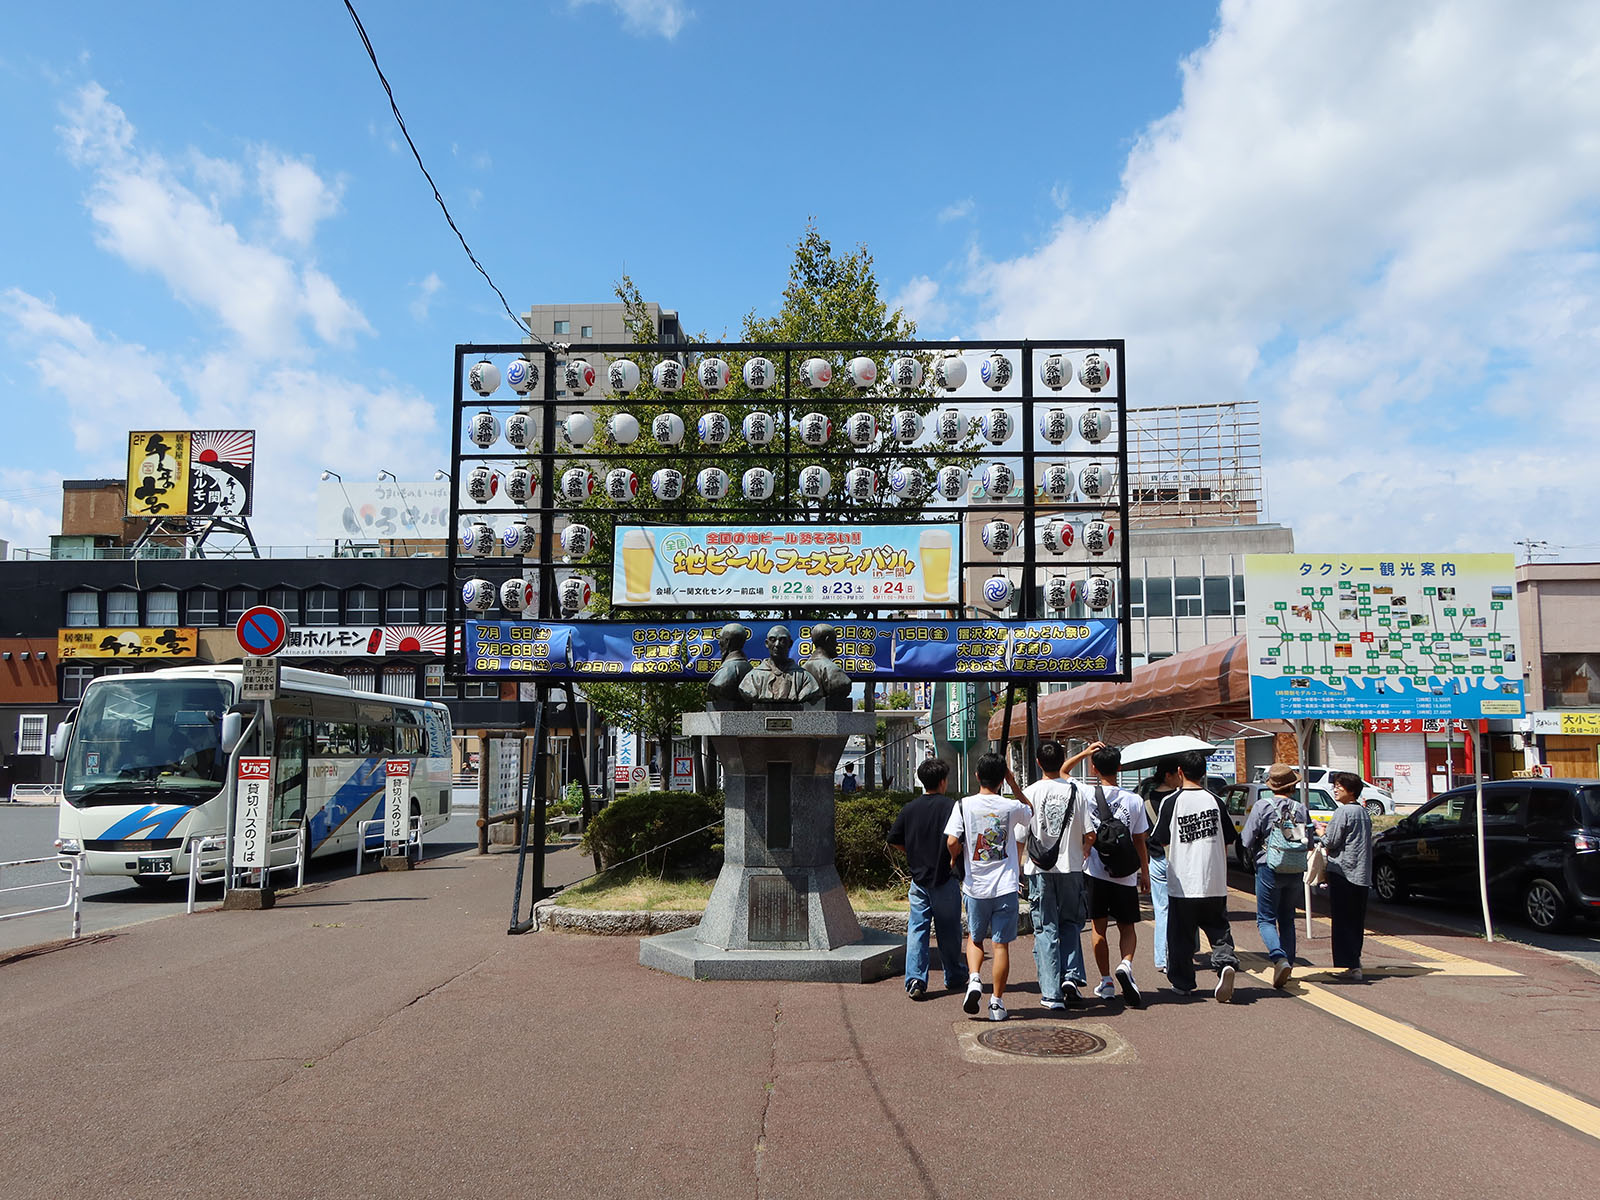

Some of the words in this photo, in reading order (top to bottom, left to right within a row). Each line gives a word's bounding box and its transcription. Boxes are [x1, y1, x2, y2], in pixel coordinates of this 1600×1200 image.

[134, 435, 146, 446] 2F
[193, 466, 208, 512] ホルモン
[665, 538, 688, 551] 全国
[674, 544, 916, 576] 地ビールフェスティバル
[1300, 562, 1456, 576] タクシー観光案内
[477, 626, 499, 638] 7月
[510, 627, 552, 640] 5日(土)
[63, 648, 76, 656] 2F
[477, 643, 550, 656] 7月26日(土)
[800, 643, 875, 656] 85日(金)
[957, 643, 1052, 656] 大原だるま祭り
[476, 659, 499, 671] 8月
[957, 656, 1107, 672] かわさき夏まつり花火大会
[1564, 714, 1600, 725] 大小ご
[1370, 724, 1412, 732] ラーメン
[241, 762, 270, 774] びゅう
[388, 764, 408, 772] びゅう
[392, 778, 402, 836] 貸切バスのりば
[243, 783, 260, 862] 貸切バスのりば
[1177, 808, 1218, 826] DECLARE
[1178, 817, 1218, 834] JUSTIFY
